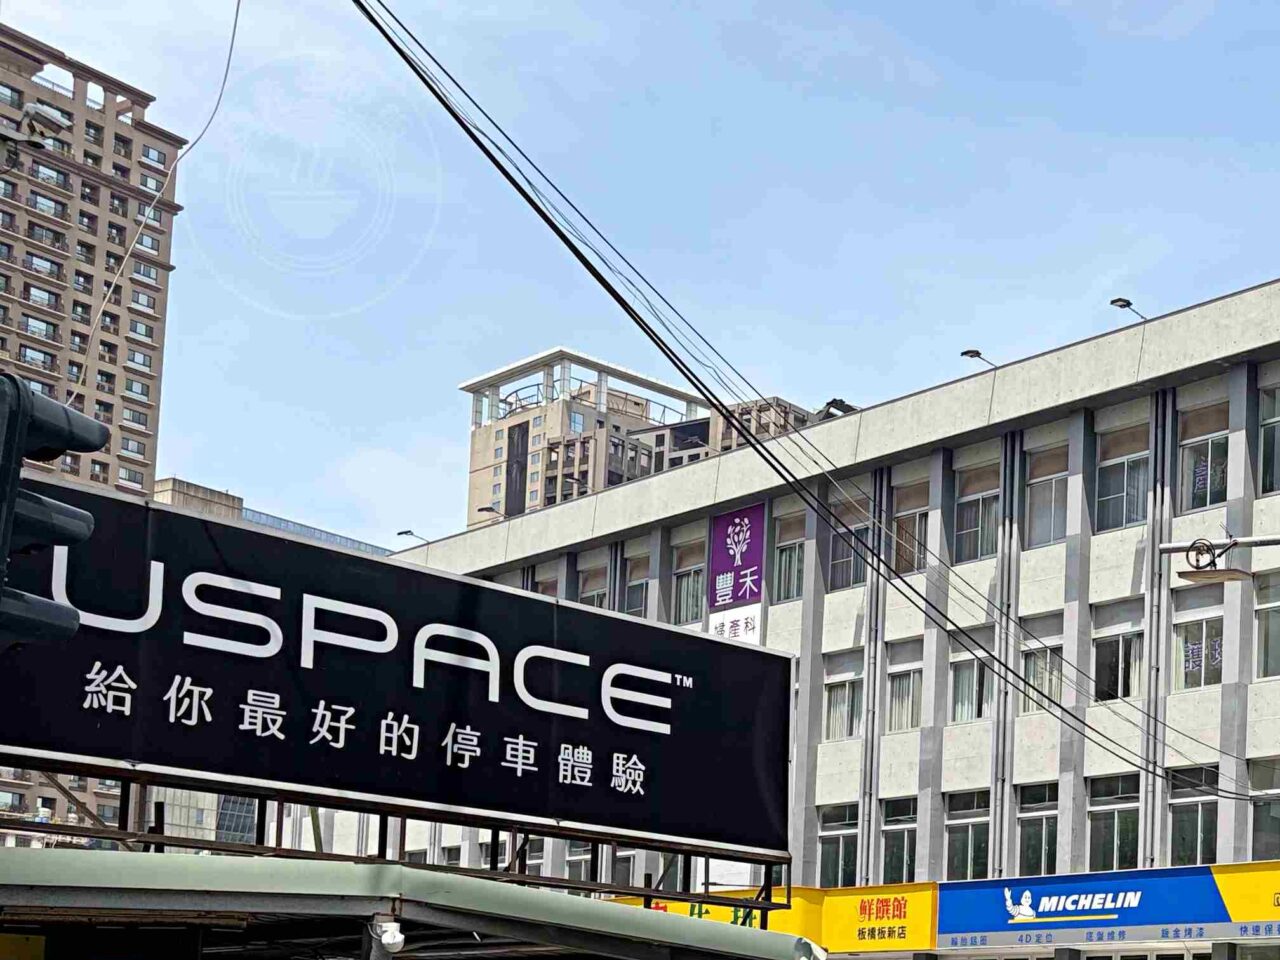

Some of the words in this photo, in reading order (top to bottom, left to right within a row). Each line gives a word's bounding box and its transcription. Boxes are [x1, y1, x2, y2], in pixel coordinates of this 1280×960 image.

[714, 566, 758, 606] 豐禾
[714, 615, 756, 639] 婦產科
[52, 545, 672, 736] USPACE
[82, 660, 647, 796] 給你最好的停車體驗
[858, 896, 908, 921] 鮮饌館
[1037, 891, 1142, 912] MICHELIN
[857, 926, 907, 941] 板橋板新店
